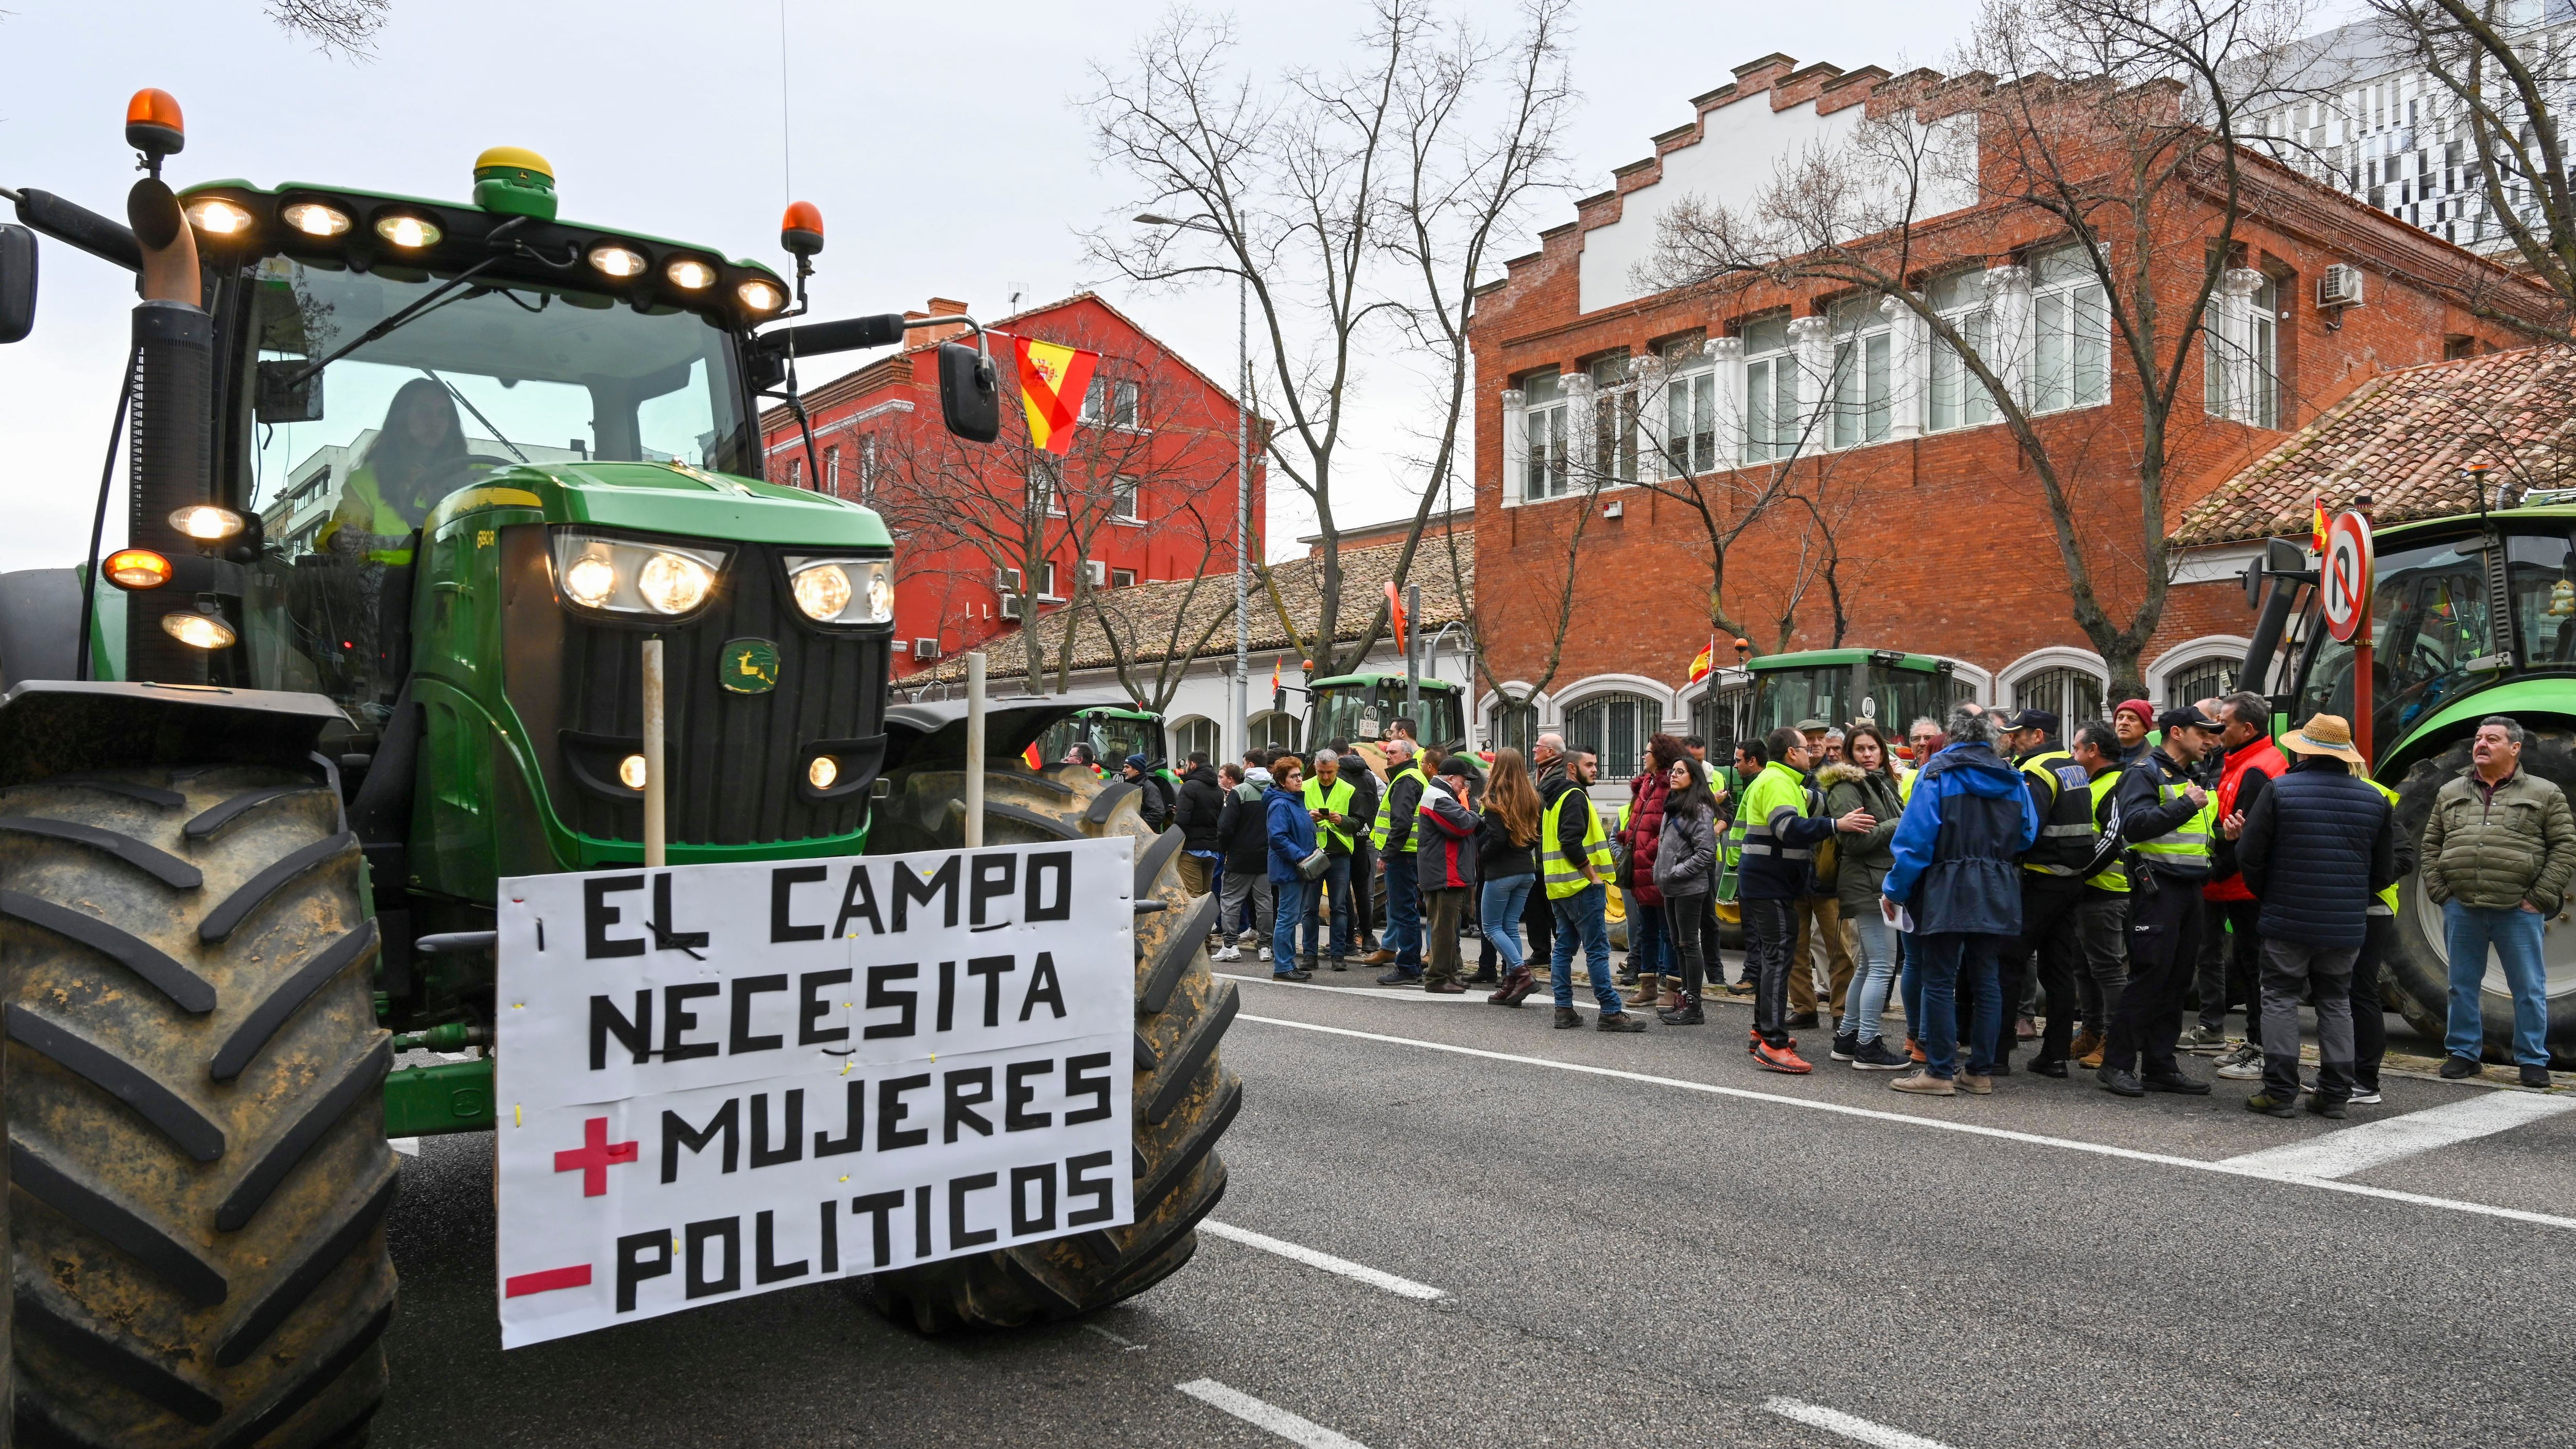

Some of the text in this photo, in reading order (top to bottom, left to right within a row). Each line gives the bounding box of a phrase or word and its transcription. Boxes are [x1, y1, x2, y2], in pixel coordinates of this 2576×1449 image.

[1365, 707, 1375, 720] 40
[1865, 699, 1872, 716] 40
[584, 851, 1072, 961] EL CAMPO
[589, 951, 1067, 1071] NECESITA
[661, 1051, 1112, 1184] MUJERES
[616, 1150, 1114, 1314] POLITICOS
